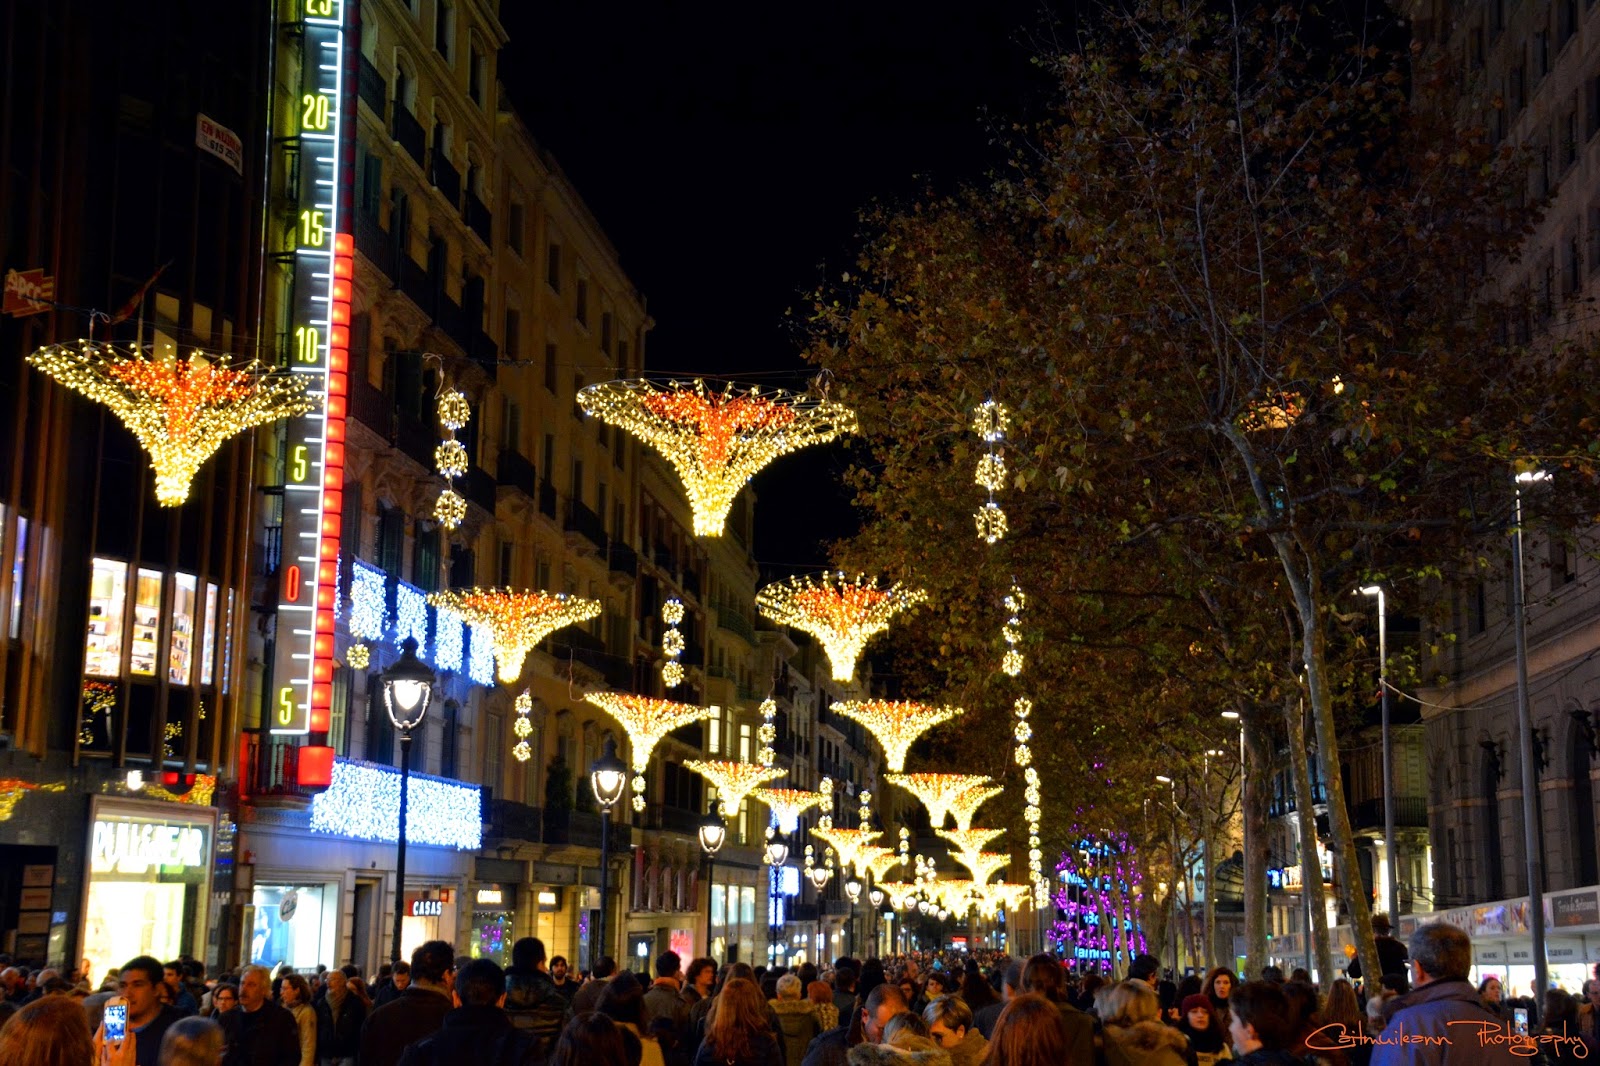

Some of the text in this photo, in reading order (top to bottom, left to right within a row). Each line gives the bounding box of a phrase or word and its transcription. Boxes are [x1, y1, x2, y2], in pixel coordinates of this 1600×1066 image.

[301, 94, 330, 131] 20
[300, 210, 327, 247] 15
[293, 326, 319, 364] 10
[293, 446, 307, 482] 5
[285, 565, 301, 602] 0
[277, 687, 294, 726] 5
[91, 821, 203, 867] PULL&BEAR
[412, 900, 442, 916] CASAS
